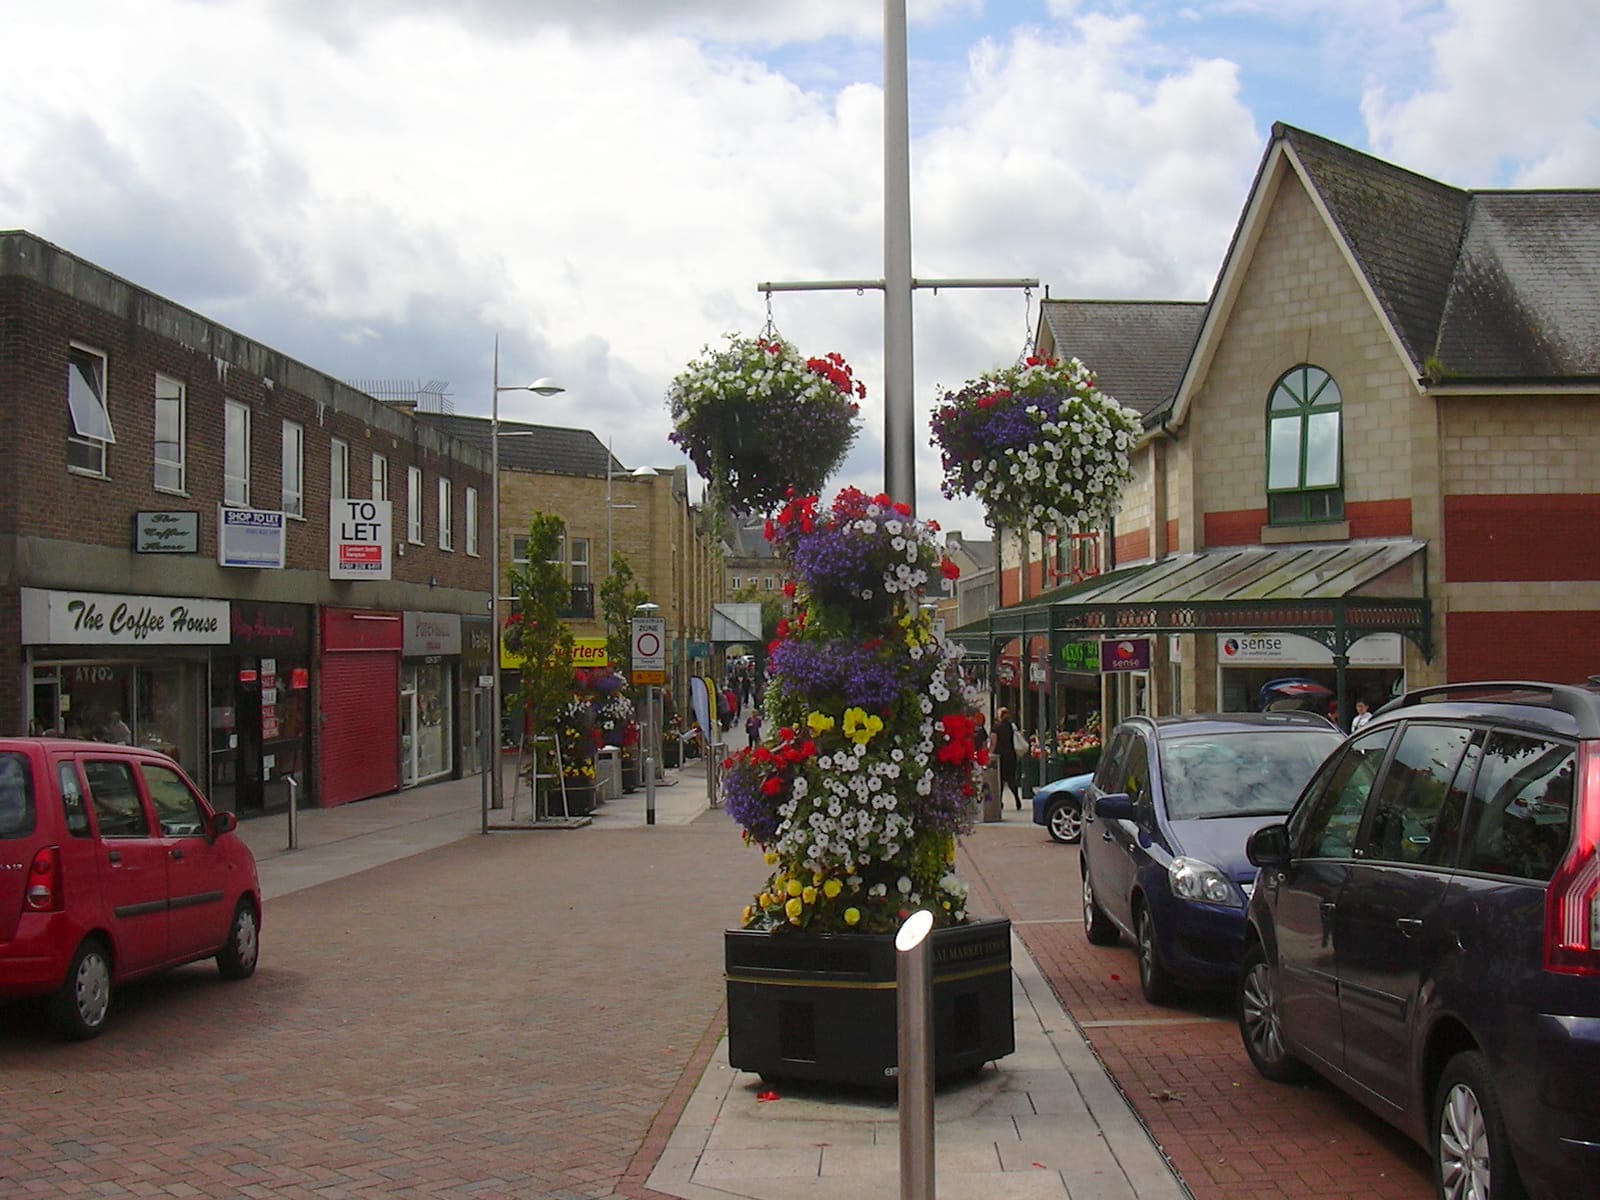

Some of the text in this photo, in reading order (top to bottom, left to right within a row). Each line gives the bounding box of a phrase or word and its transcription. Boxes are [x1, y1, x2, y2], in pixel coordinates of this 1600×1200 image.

[227, 511, 250, 523] SHOP
[253, 513, 266, 524] TO
[266, 513, 280, 524] LET
[347, 502, 376, 521] TO
[151, 514, 180, 524] The
[143, 527, 190, 540] Coffee
[341, 522, 382, 541] LET
[141, 541, 187, 551] House
[67, 600, 104, 631] The
[109, 602, 165, 640] Coffee
[170, 606, 218, 633] House
[1241, 637, 1282, 650] sense
[1112, 659, 1140, 668] sense
